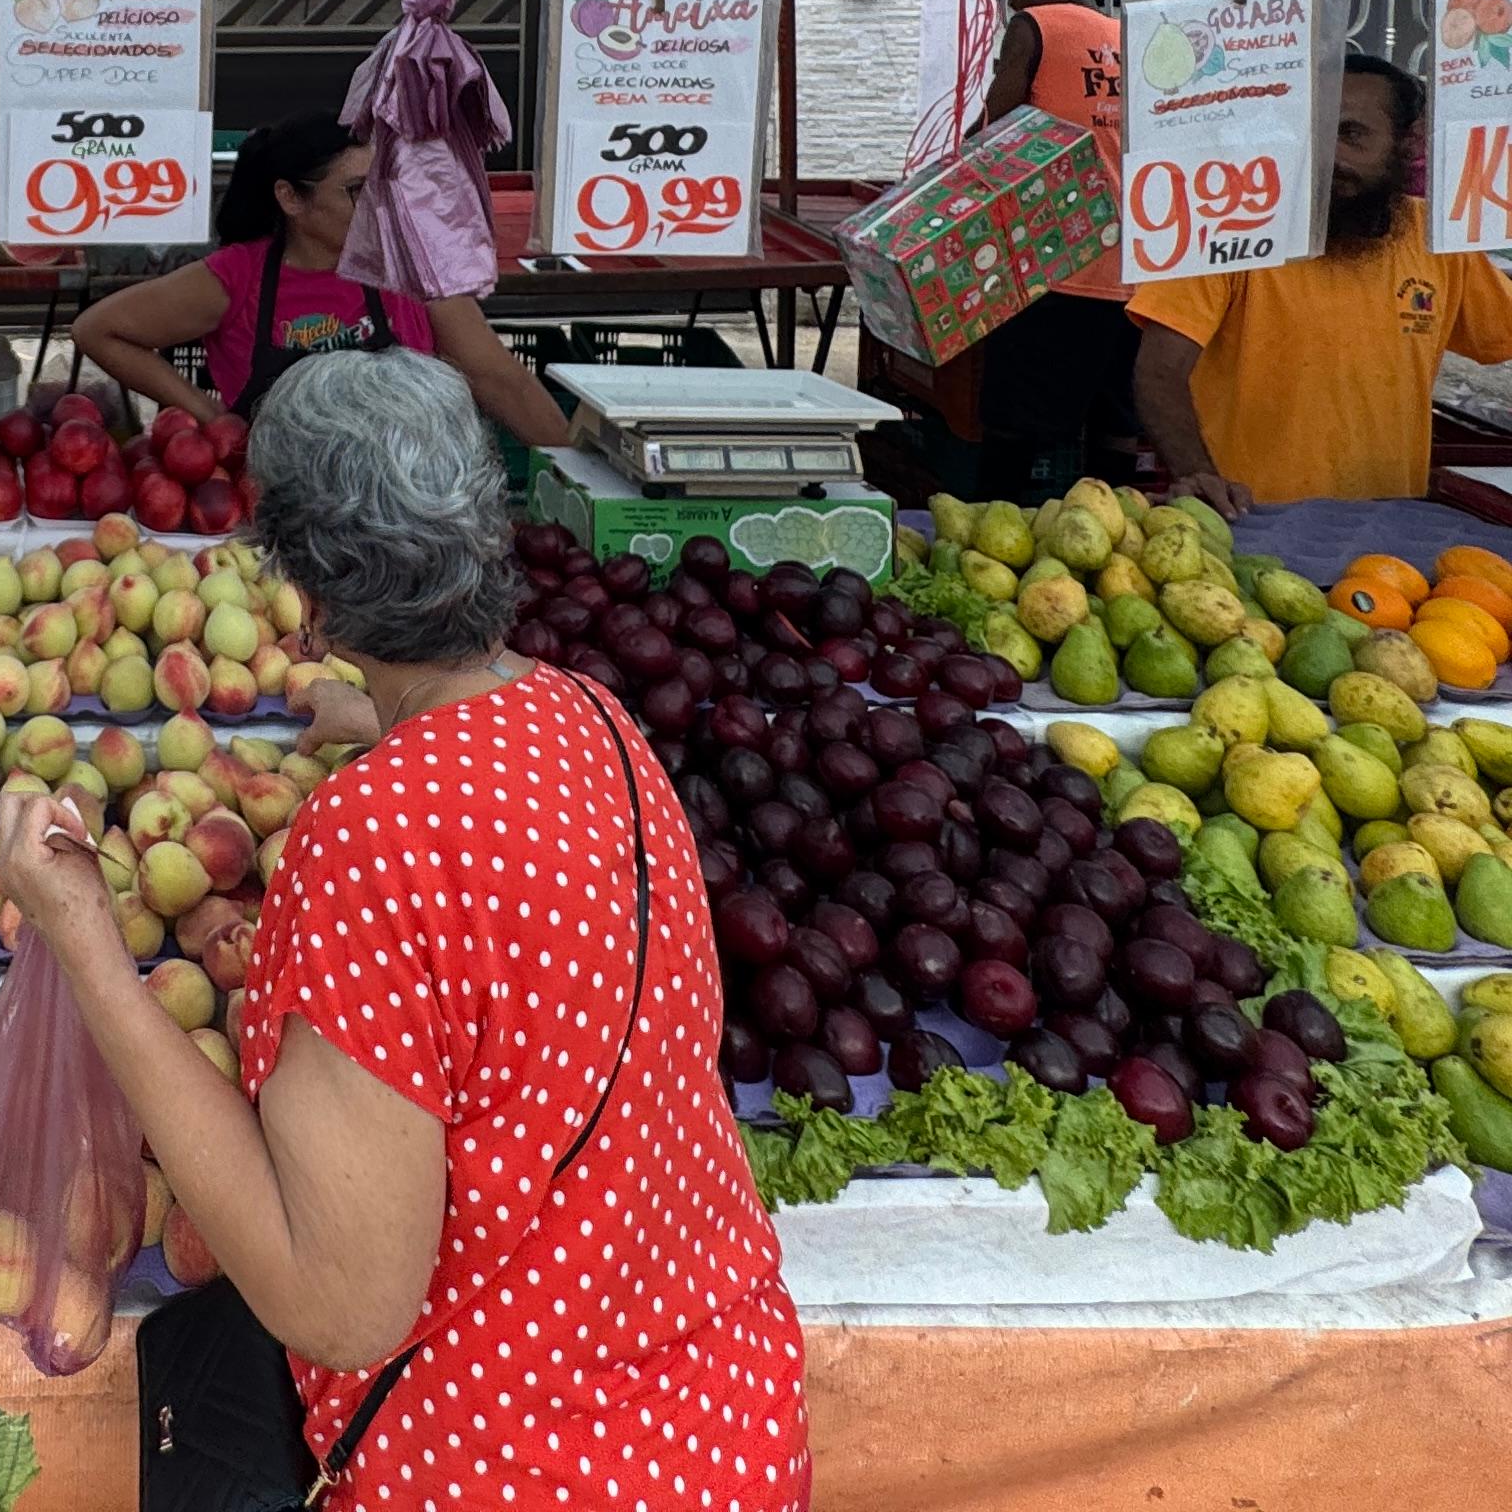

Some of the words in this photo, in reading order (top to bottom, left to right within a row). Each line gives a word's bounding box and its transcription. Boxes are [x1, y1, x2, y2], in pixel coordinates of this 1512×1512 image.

[18, 39, 172, 57] SELECIONADOS
[1222, 31, 1298, 52] VERMELHA
[651, 60, 688, 69] DOCE
[1440, 57, 1473, 72] BEM
[576, 75, 715, 90] SELECIONADAS
[1439, 72, 1474, 85] DOCE
[592, 92, 647, 105] BEM
[656, 93, 713, 104] DOCE
[52, 110, 144, 142] 500
[71, 140, 136, 158] GRAMA
[600, 123, 708, 162] 500
[628, 157, 686, 174] GRAMA
[1209, 237, 1274, 265] KILO
